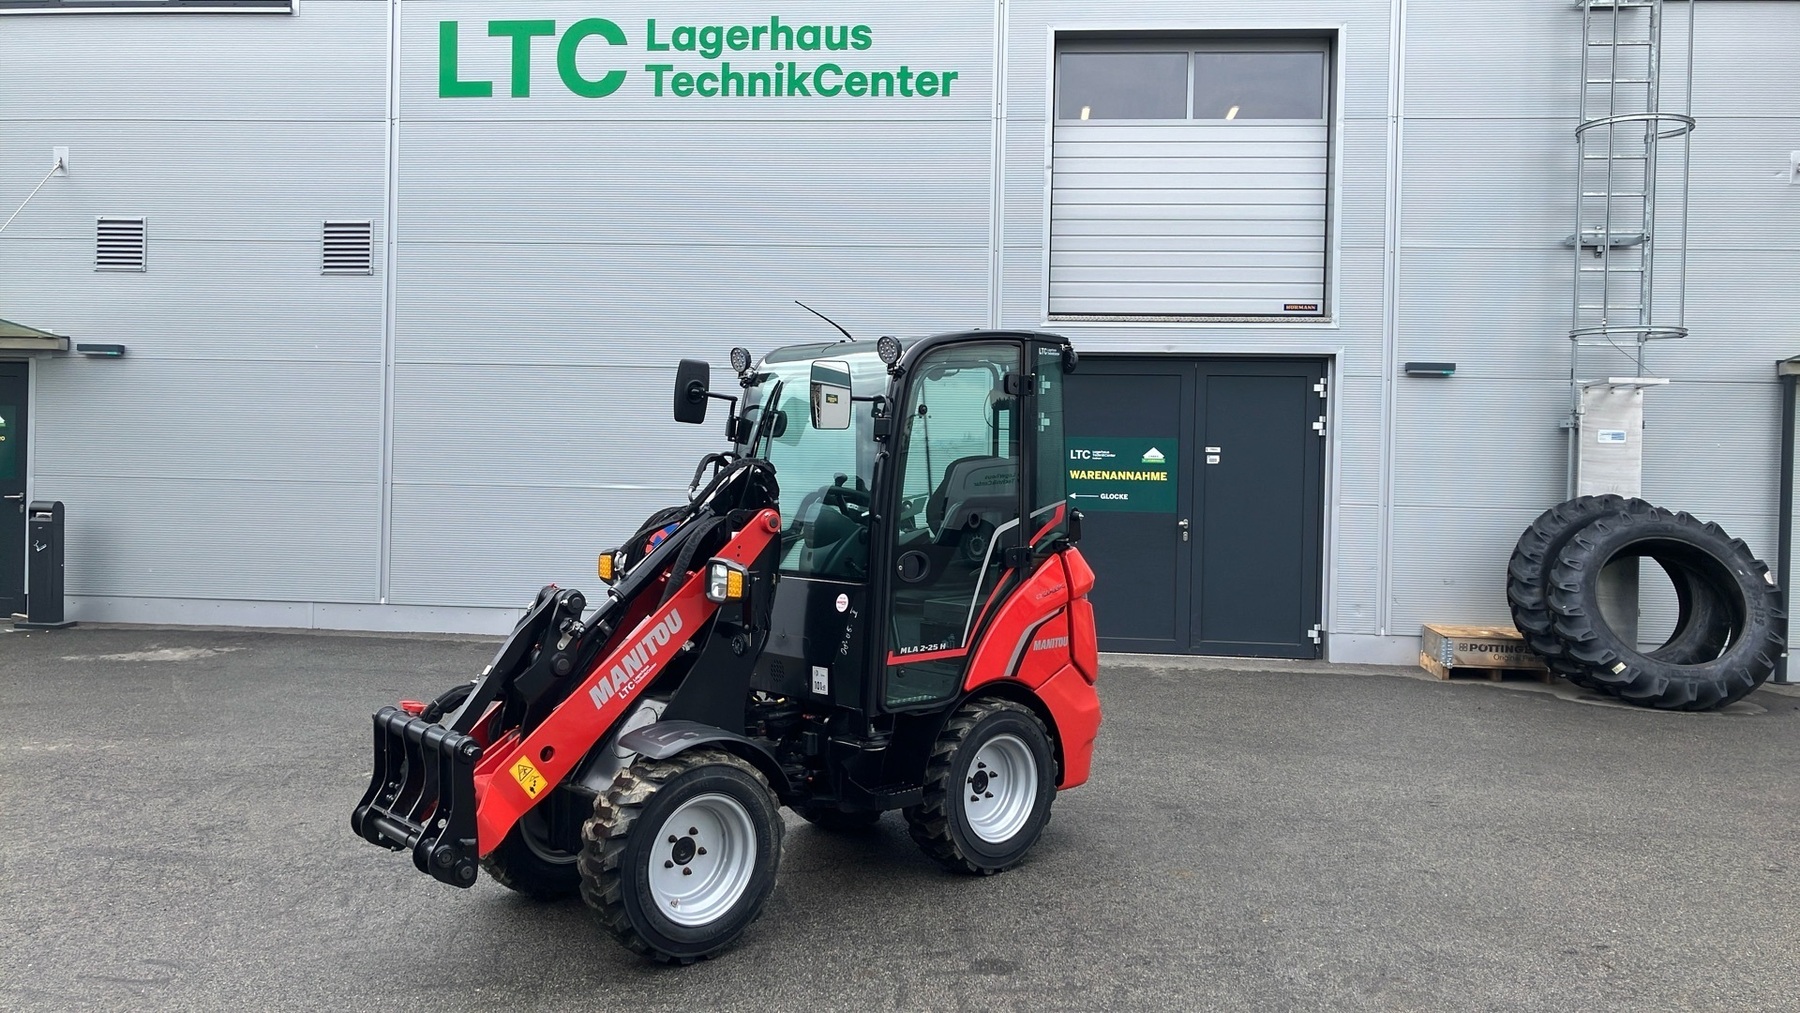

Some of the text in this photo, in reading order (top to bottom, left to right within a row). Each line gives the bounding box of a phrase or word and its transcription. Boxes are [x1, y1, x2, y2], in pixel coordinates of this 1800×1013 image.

[646, 16, 873, 60] Lagerhaus
[438, 18, 628, 99] LTC
[645, 62, 959, 98] TechnikCenter
[1070, 449, 1091, 460] LTC
[1069, 470, 1168, 481] WARENANNAHME
[900, 642, 947, 655] MLA 2-25 H
[1033, 636, 1069, 651] MANITOU
[588, 608, 683, 710] MANITOU
[618, 681, 636, 700] LTC
